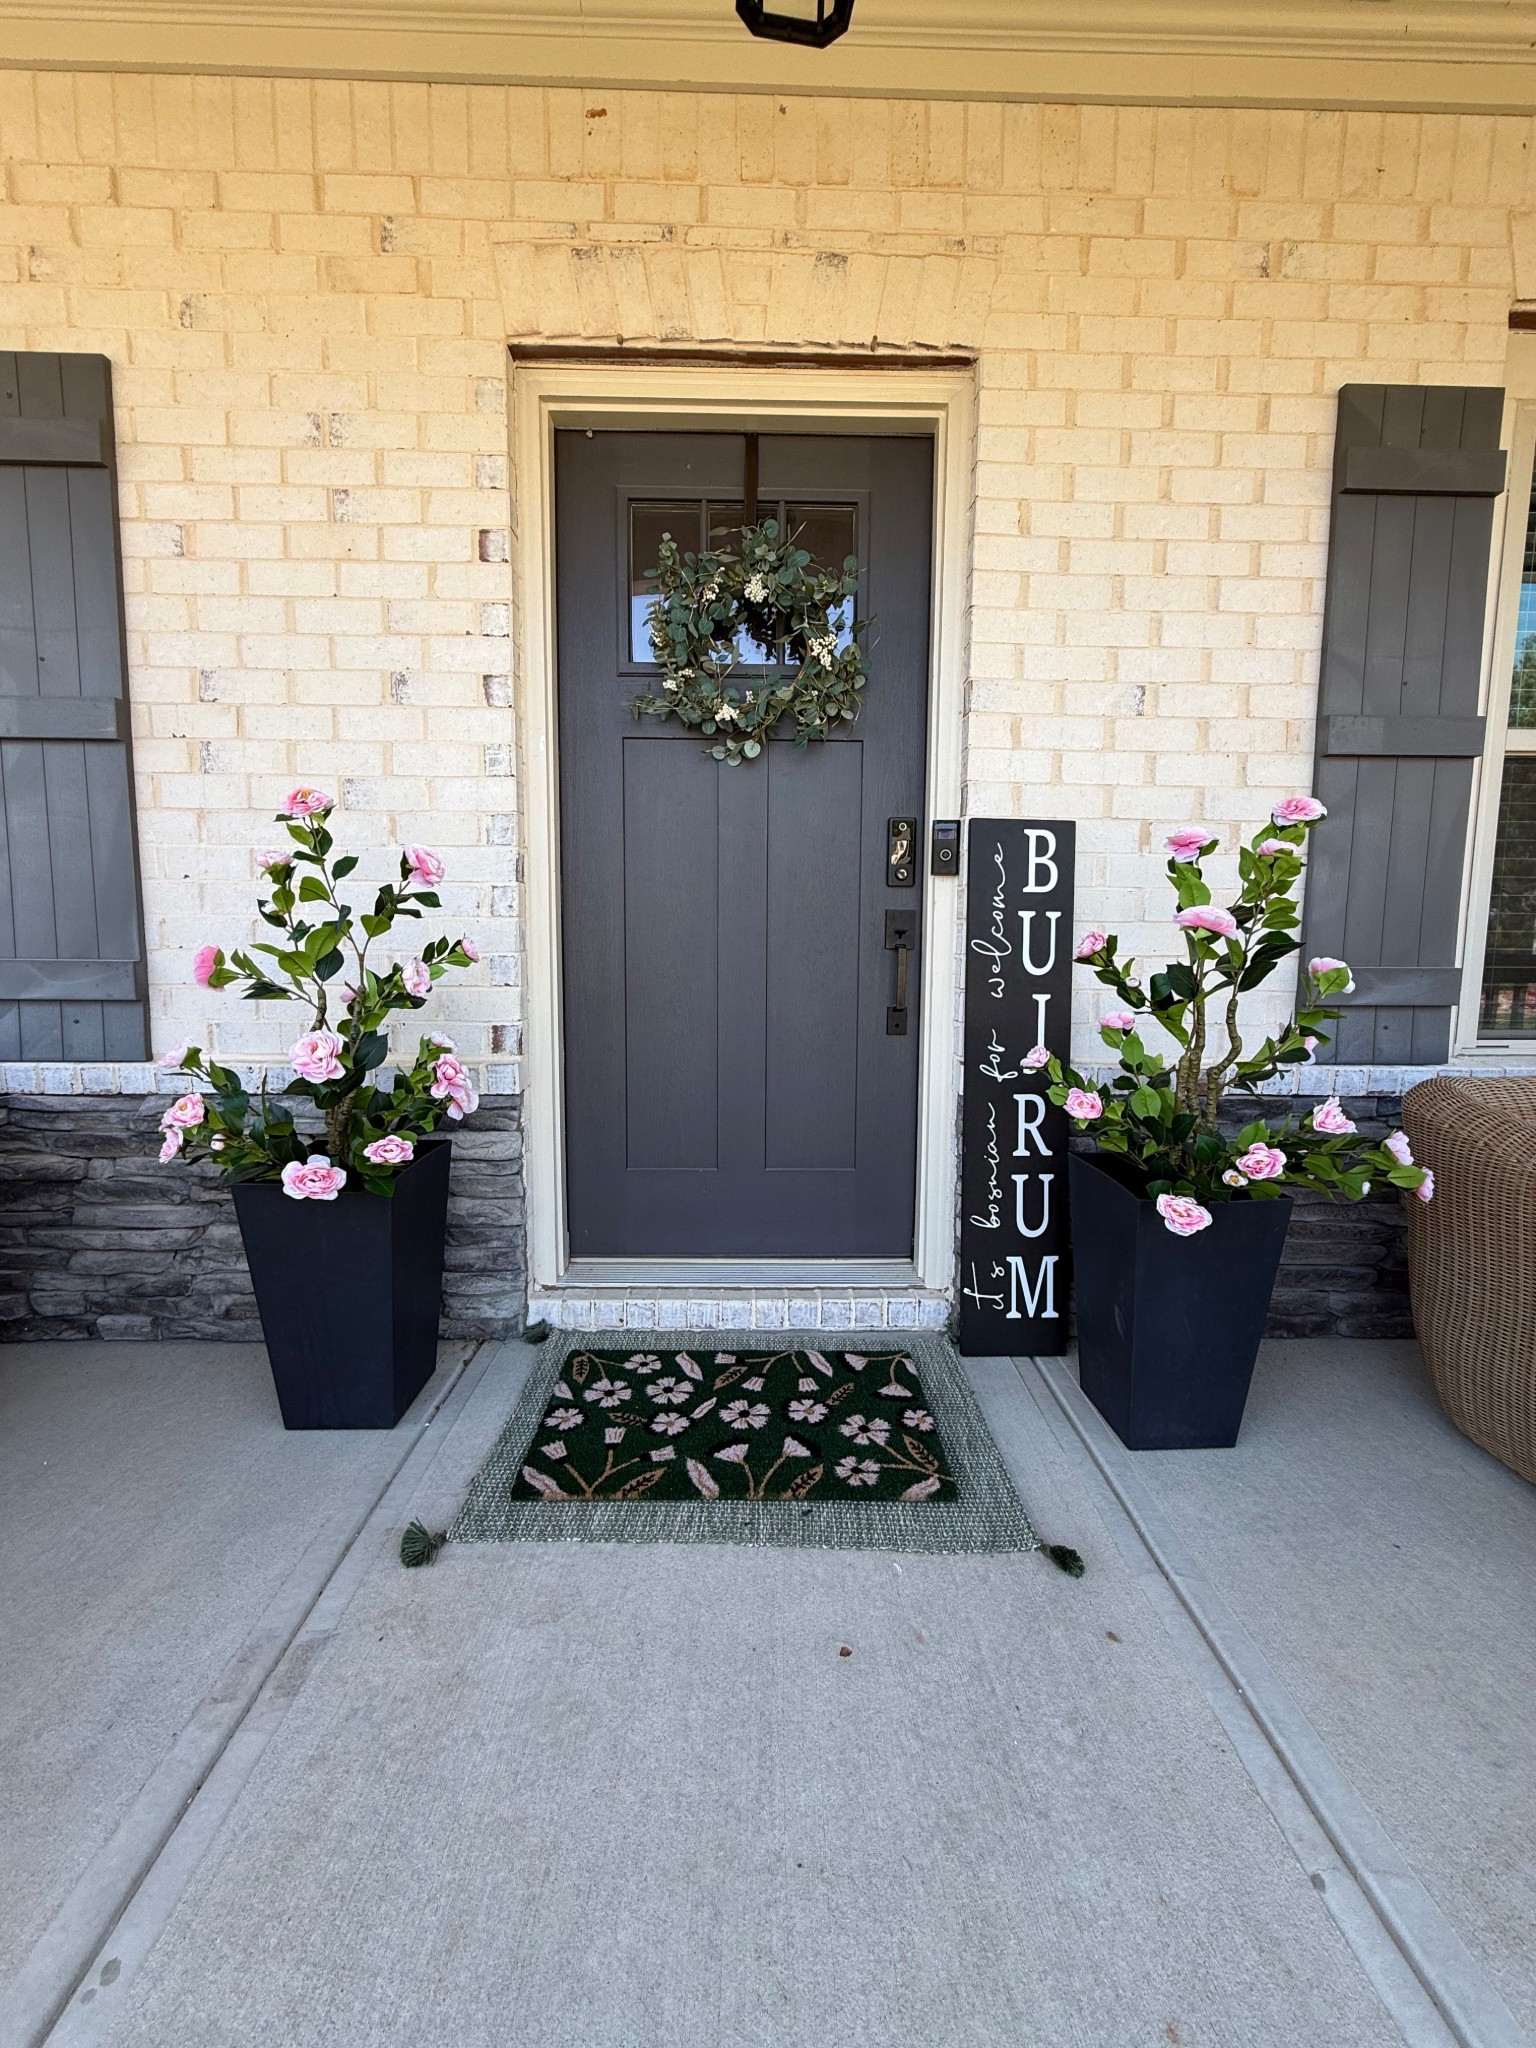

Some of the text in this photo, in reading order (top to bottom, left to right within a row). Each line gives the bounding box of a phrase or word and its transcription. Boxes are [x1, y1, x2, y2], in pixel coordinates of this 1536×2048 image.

[963, 842, 1018, 1310] its bosnian for welcome
